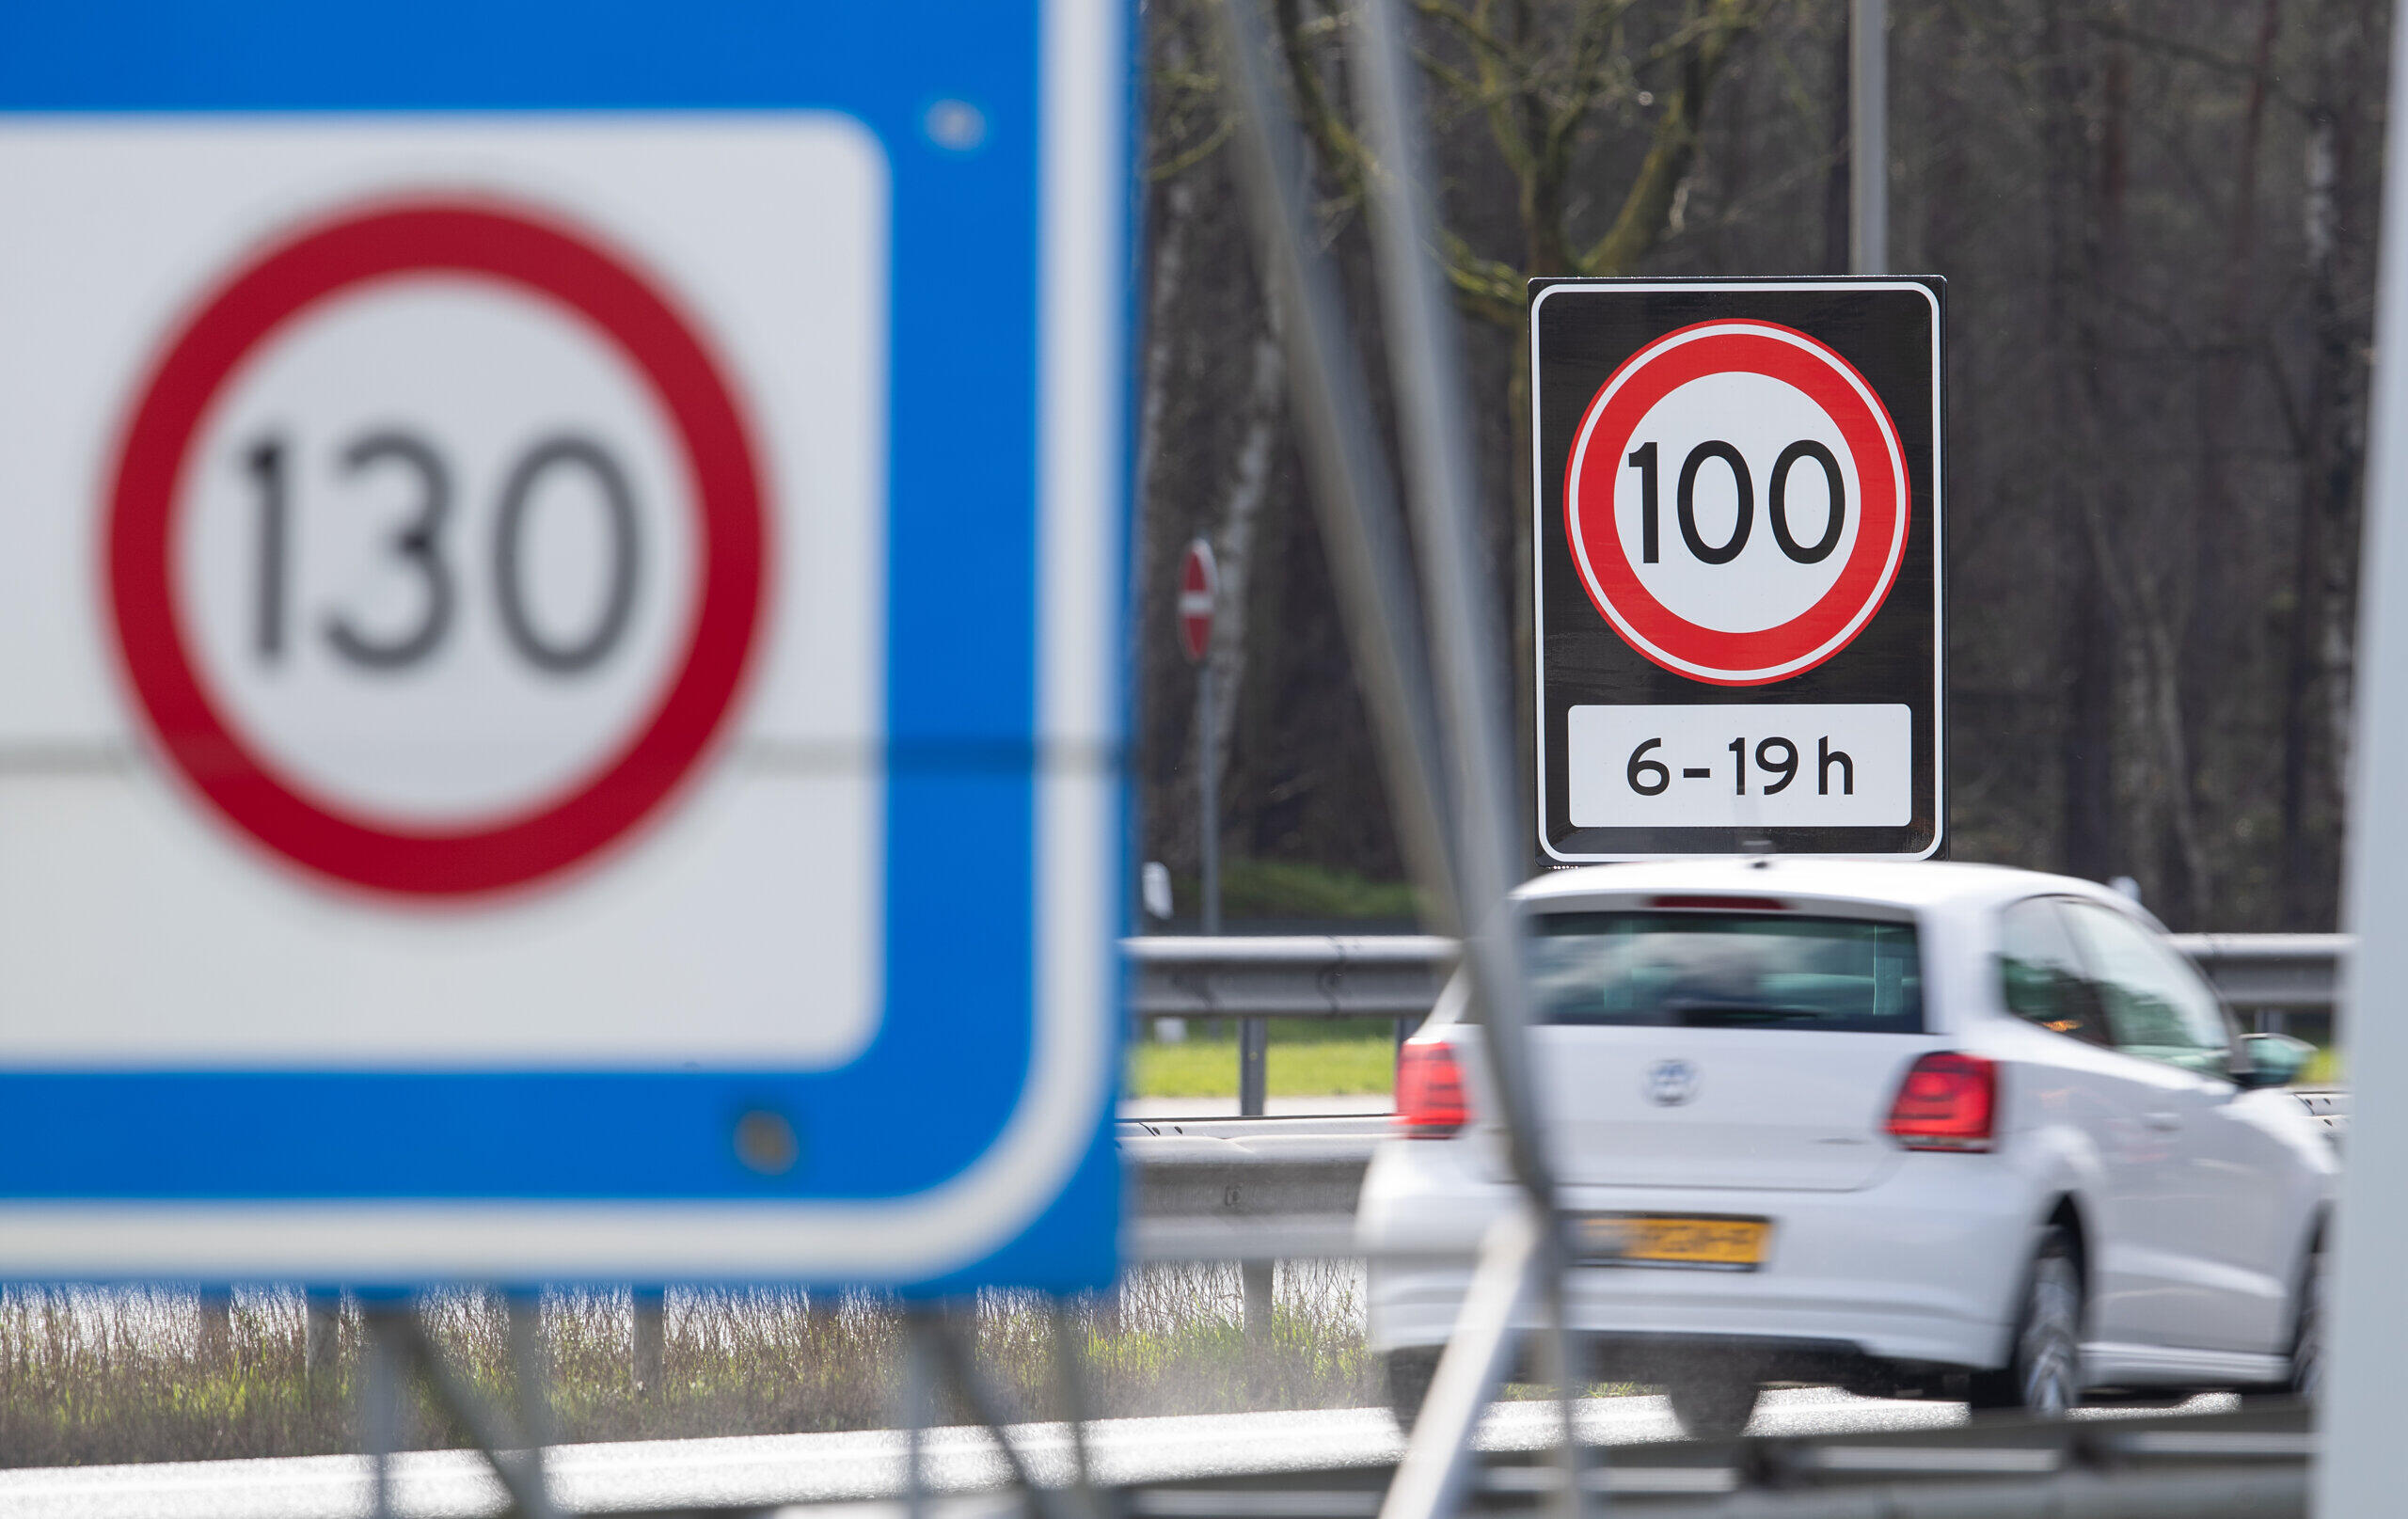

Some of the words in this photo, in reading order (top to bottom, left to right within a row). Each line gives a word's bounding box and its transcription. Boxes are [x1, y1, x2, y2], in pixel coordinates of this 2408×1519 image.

[240, 432, 642, 678] 130
[1627, 439, 1846, 565] 100
[1626, 736, 1799, 797] 6-19
[1818, 735, 1854, 796] h
